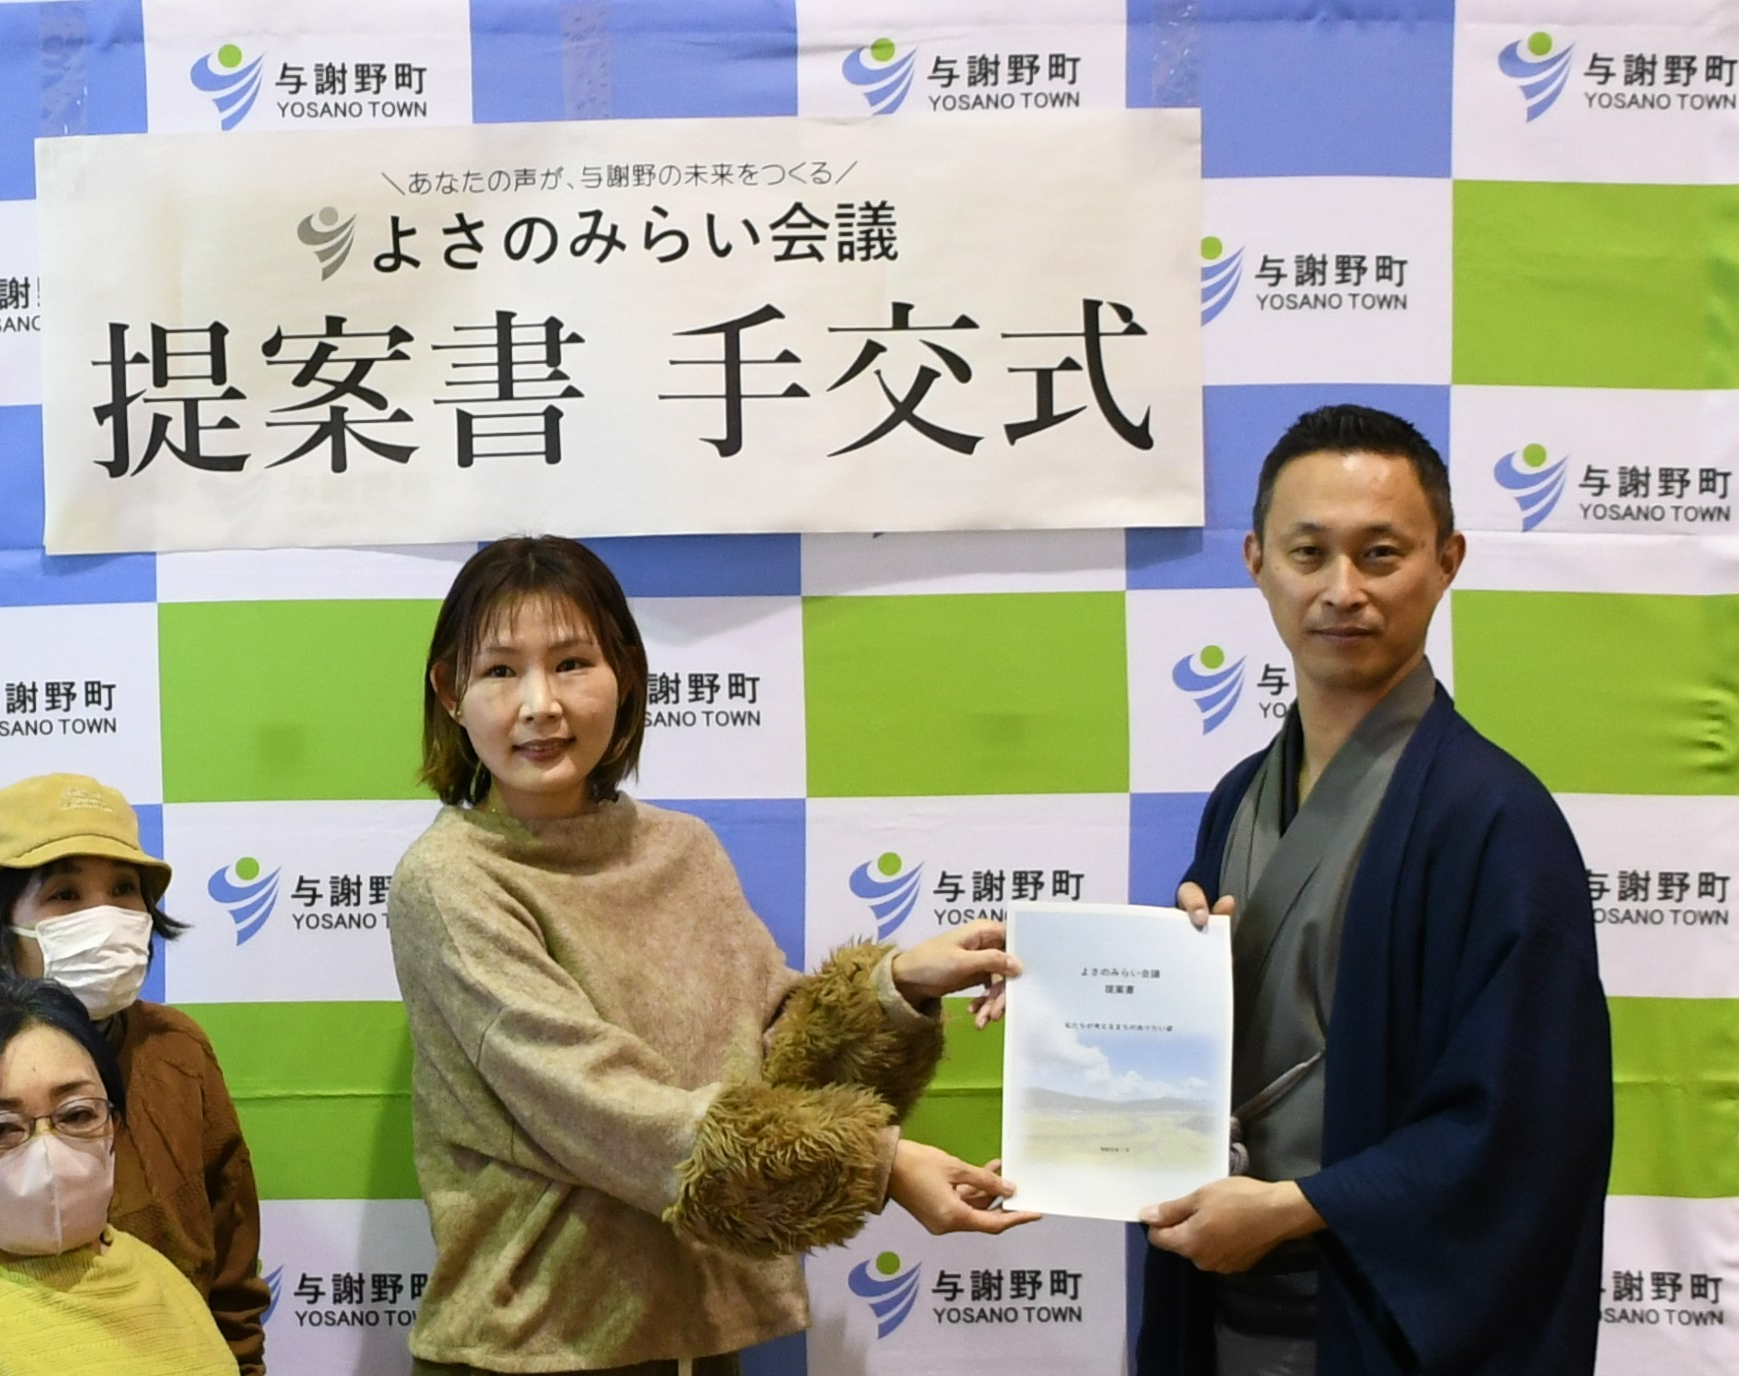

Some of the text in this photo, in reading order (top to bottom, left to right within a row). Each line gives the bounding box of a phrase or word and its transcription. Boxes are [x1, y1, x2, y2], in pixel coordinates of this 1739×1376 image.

[274, 61, 427, 96] 与謝野町
[927, 53, 1082, 89] 与謝野町
[1583, 52, 1739, 88] 与謝野町
[276, 100, 427, 119] YOSANO TOWN
[928, 91, 1080, 112] YOSANO TOWN
[1584, 91, 1737, 111] YOSANO TOWN
[373, 200, 899, 273] よさのみらい会議
[1254, 253, 1409, 288] 与謝野町
[1255, 292, 1408, 311] YOSANO TOWN
[90, 298, 1155, 479] 提案書 手交式
[1578, 464, 1733, 500] 与謝野町
[1579, 503, 1731, 523] YOSANO TOWN
[57, 717, 117, 735] TOWN
[700, 710, 761, 727] TOWN
[932, 869, 1085, 903] 与謝野町
[292, 912, 378, 930] YOSANO
[933, 908, 1007, 926] YOSAN
[1669, 908, 1729, 926] TOWN
[931, 1268, 1083, 1303] 与謝野町
[1600, 1270, 1724, 1305] 謝野町
[294, 1309, 379, 1327] YOSANO
[932, 1306, 1083, 1325] YOSANO TOWN
[1665, 1308, 1726, 1327] TOWN
